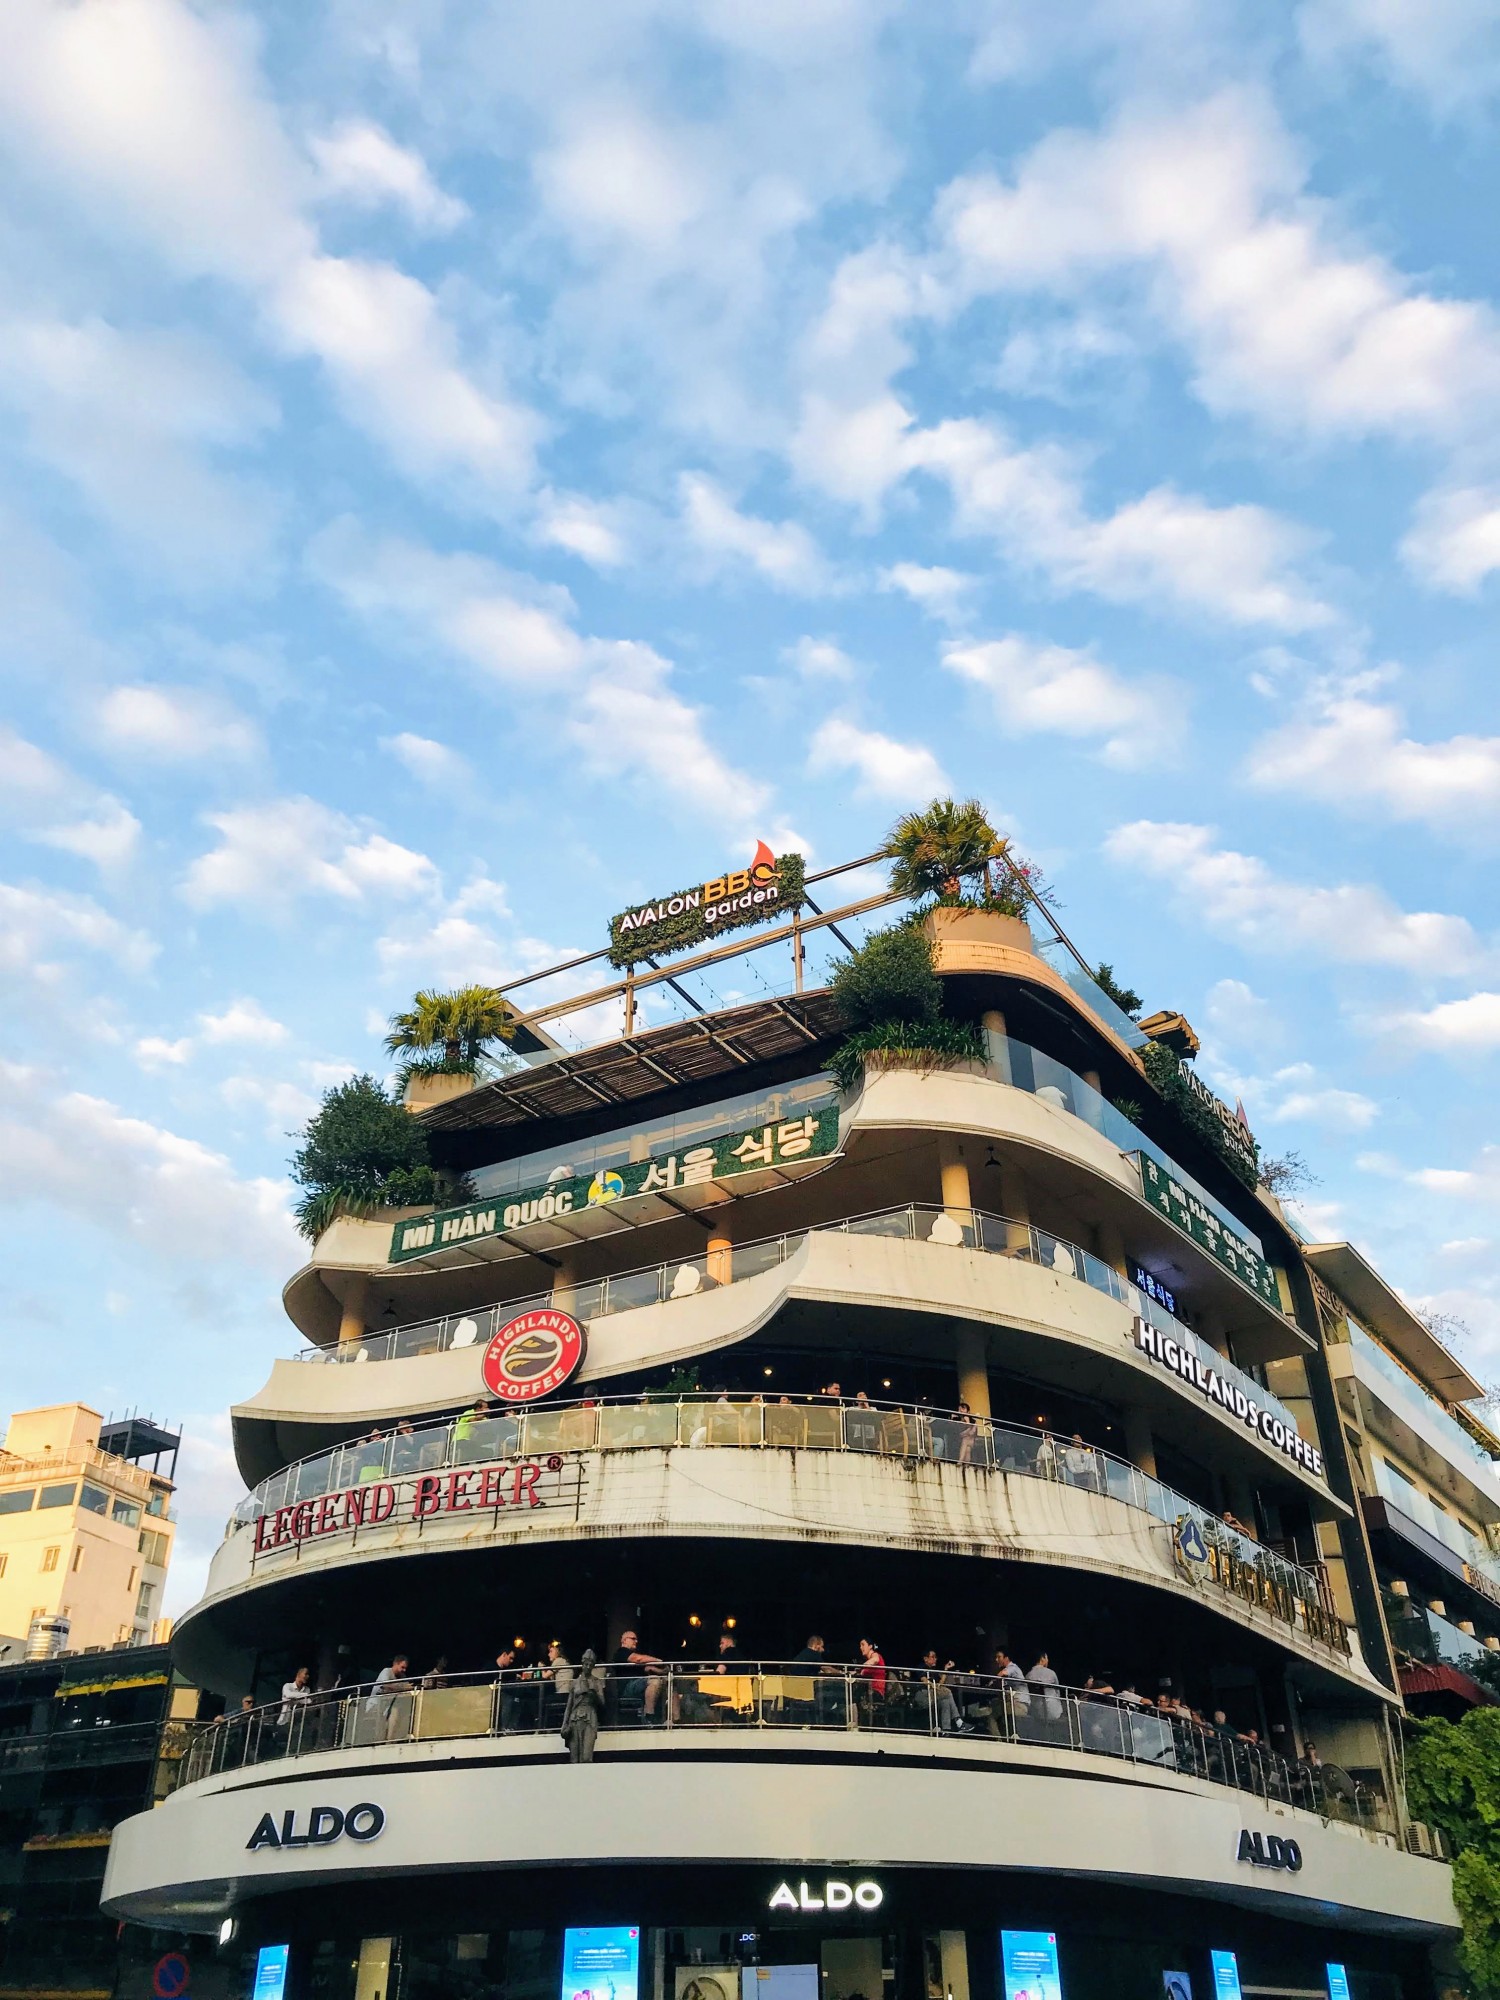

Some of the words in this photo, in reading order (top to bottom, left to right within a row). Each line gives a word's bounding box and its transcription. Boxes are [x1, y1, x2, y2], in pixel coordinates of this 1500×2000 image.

[620, 890, 700, 934] AVALON
[704, 886, 779, 924] garden
[1178, 1059, 1221, 1119] AVALON
[638, 1147, 719, 1192] 서울
[731, 1115, 820, 1164] 식당
[402, 1218, 435, 1251] MÌ
[488, 1314, 577, 1361] HIGHLANDS
[497, 1367, 566, 1397] COFFEE
[1137, 1319, 1259, 1429] HIGHLANDS
[1260, 1411, 1323, 1476] COFFEE
[253, 1483, 396, 1551] LEGEND
[413, 1463, 544, 1517] BEER
[245, 1802, 386, 1851] ALDO
[1236, 1828, 1303, 1872] ALDO
[768, 1881, 884, 1909] ALDO
